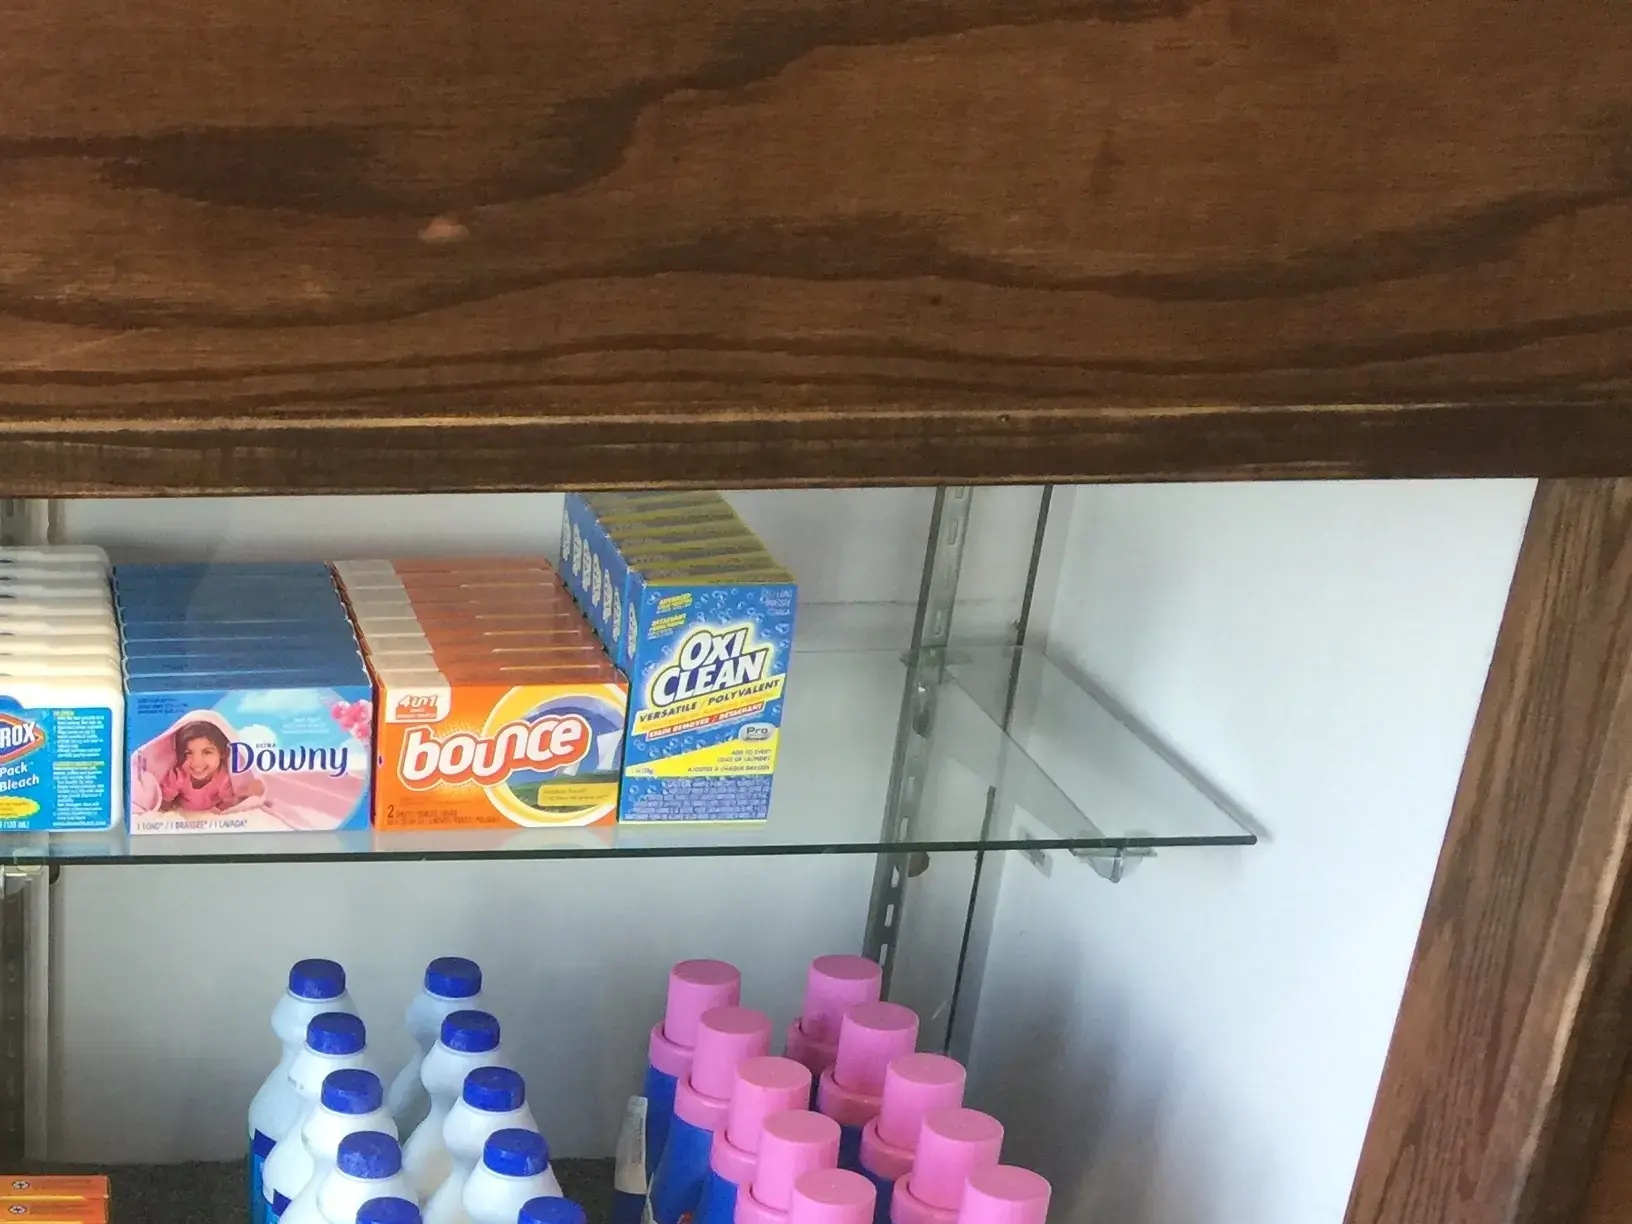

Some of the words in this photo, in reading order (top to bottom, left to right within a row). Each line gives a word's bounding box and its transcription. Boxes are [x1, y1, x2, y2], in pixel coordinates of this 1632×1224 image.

[679, 627, 749, 671] OXI
[652, 648, 769, 707] CLEAN
[639, 702, 696, 723] VERSATILE
[708, 679, 780, 705] POLYVALENT
[401, 715, 583, 782] bounce
[746, 726, 768, 734] Pro
[229, 742, 348, 777] Downy
[0, 774, 40, 792] Bleach
[387, 804, 394, 818] 2
